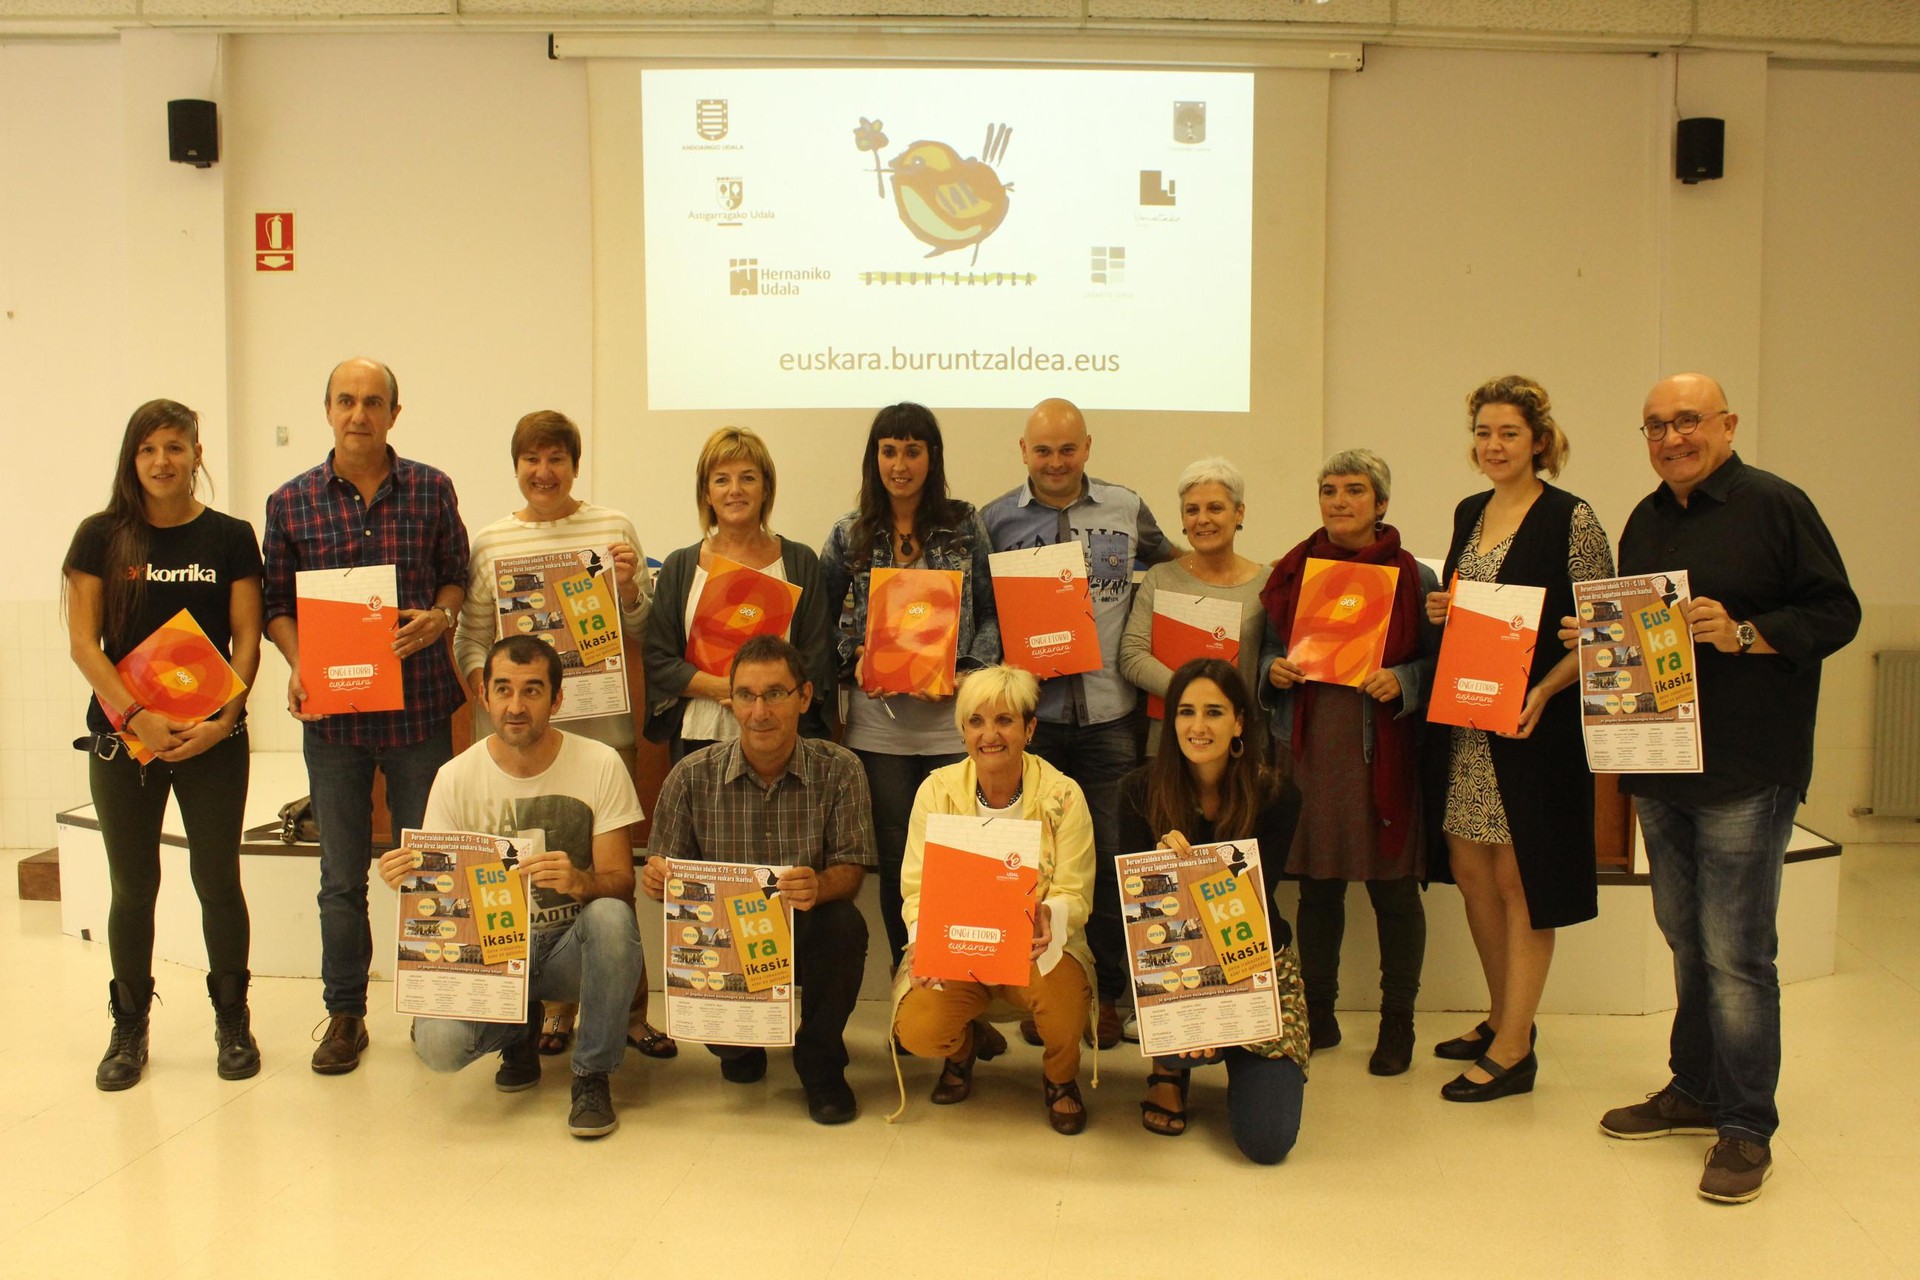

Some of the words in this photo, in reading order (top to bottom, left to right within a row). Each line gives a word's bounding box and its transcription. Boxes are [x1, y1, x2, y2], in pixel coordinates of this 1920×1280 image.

[688, 210, 748, 222] Astigarragako
[750, 210, 776, 220] Udala
[760, 267, 831, 280] Hernaniko
[865, 272, 1033, 286] BURUNTZALDEA
[761, 282, 800, 296] Udala
[779, 346, 1120, 372] euskara.buruntzaldea.eus
[146, 563, 216, 584] korrika
[562, 577, 593, 597] Eus
[569, 595, 601, 617] ka
[739, 606, 757, 618] aek
[908, 605, 925, 615] aek
[1340, 597, 1358, 607] aek
[579, 614, 606, 635] ra
[1640, 608, 1670, 630] Eus
[579, 630, 618, 650] ikasiz
[1647, 629, 1677, 652] ka
[1655, 651, 1682, 675] ra
[176, 669, 192, 686] aek
[1655, 672, 1693, 694] ikasiz
[463, 798, 518, 838] USA
[475, 868, 507, 885] Eus
[479, 886, 512, 908] ka
[1200, 877, 1237, 902] Eus
[733, 899, 768, 916] Eus
[1207, 898, 1246, 924] ka
[486, 911, 514, 931] ra
[738, 917, 773, 938] ka
[483, 931, 526, 948] ikasiz
[1220, 921, 1254, 947] ra
[747, 938, 778, 960] ra
[1220, 940, 1268, 966] ikasiz
[745, 958, 790, 976] ikasiz
